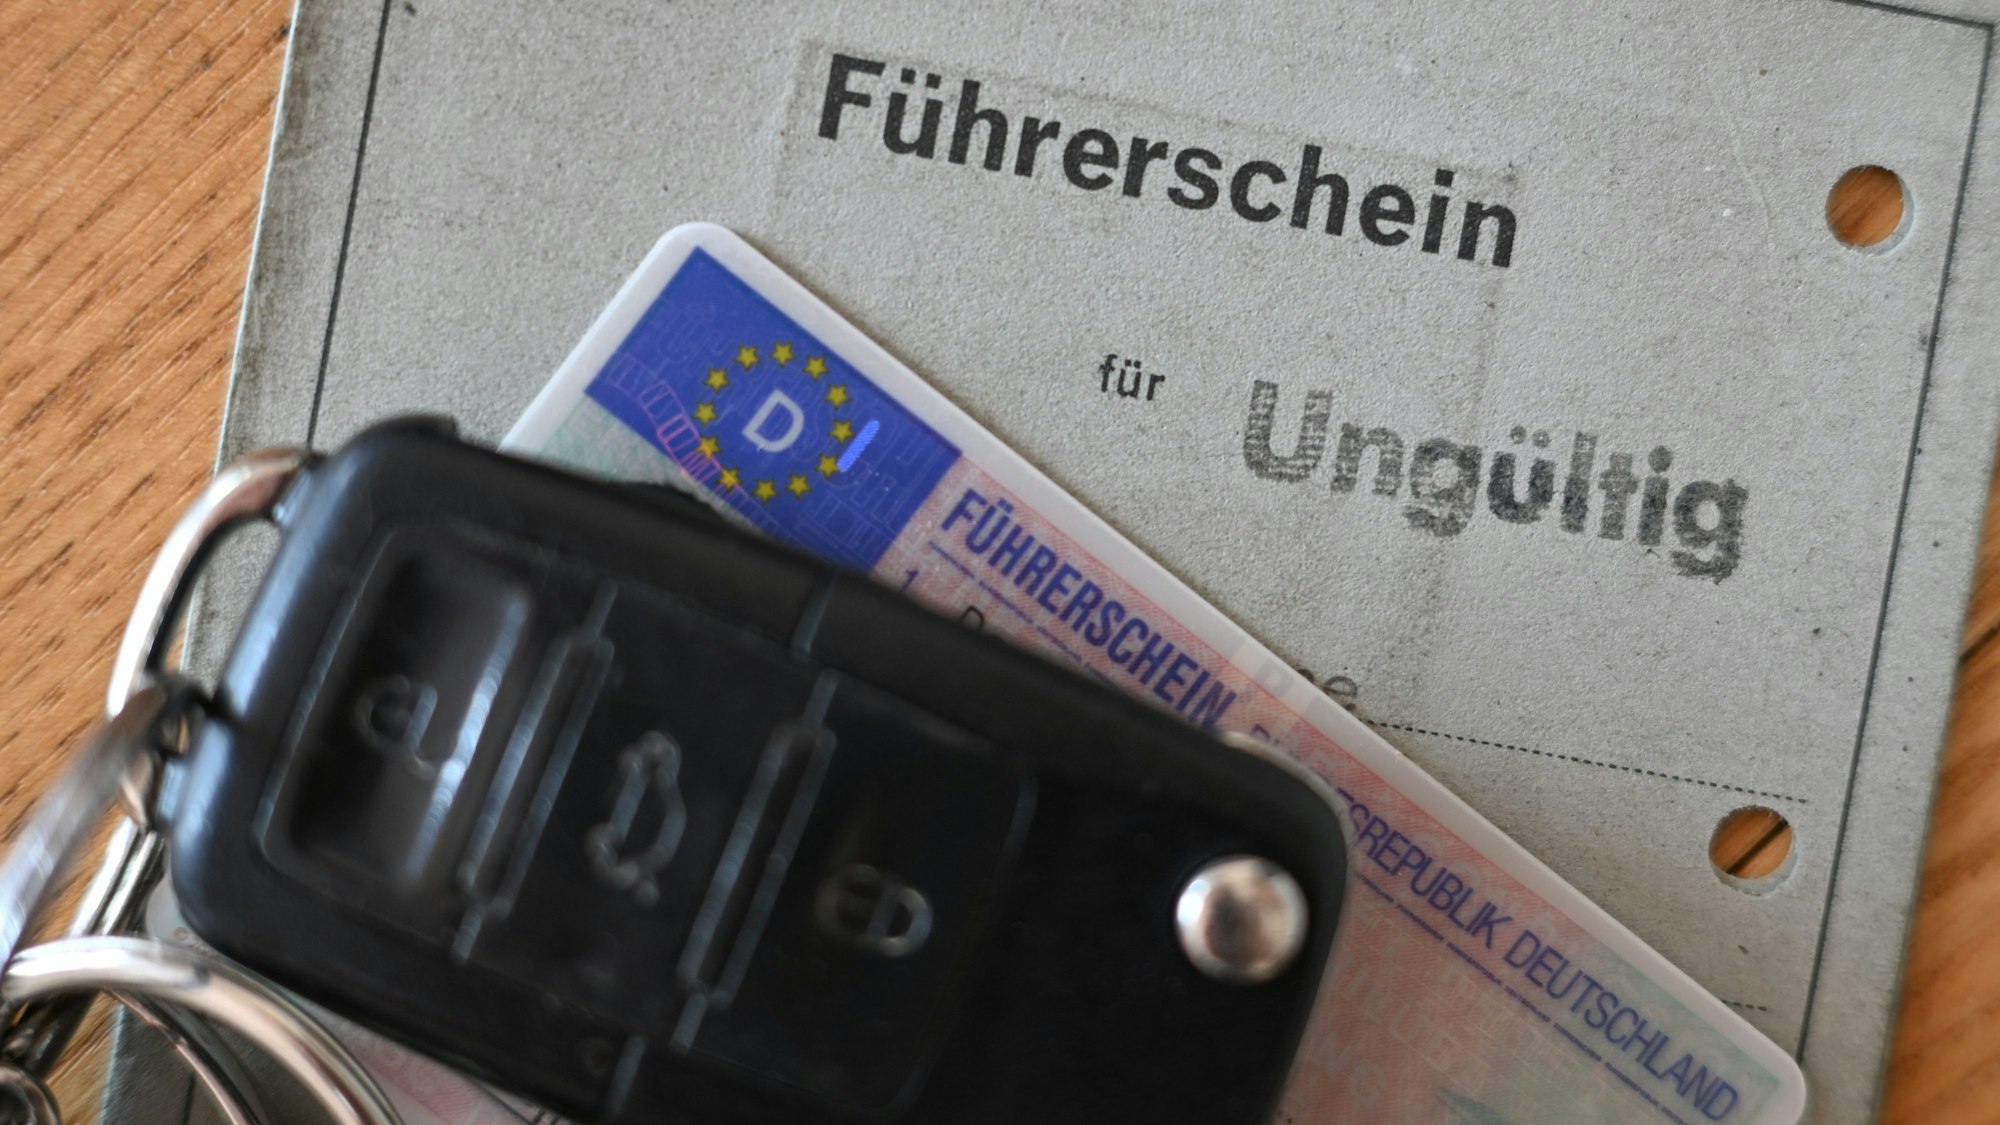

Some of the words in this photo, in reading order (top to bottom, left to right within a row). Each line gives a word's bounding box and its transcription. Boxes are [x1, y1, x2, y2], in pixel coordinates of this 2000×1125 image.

[818, 53, 1517, 268] Führerschein
[742, 388, 804, 453] D
[1099, 353, 1165, 401] für
[1244, 379, 1748, 585] Ungültig
[941, 488, 1237, 729] FÜHRERSCHEIN
[1503, 929, 1738, 1121] DEUTSCHLAND
